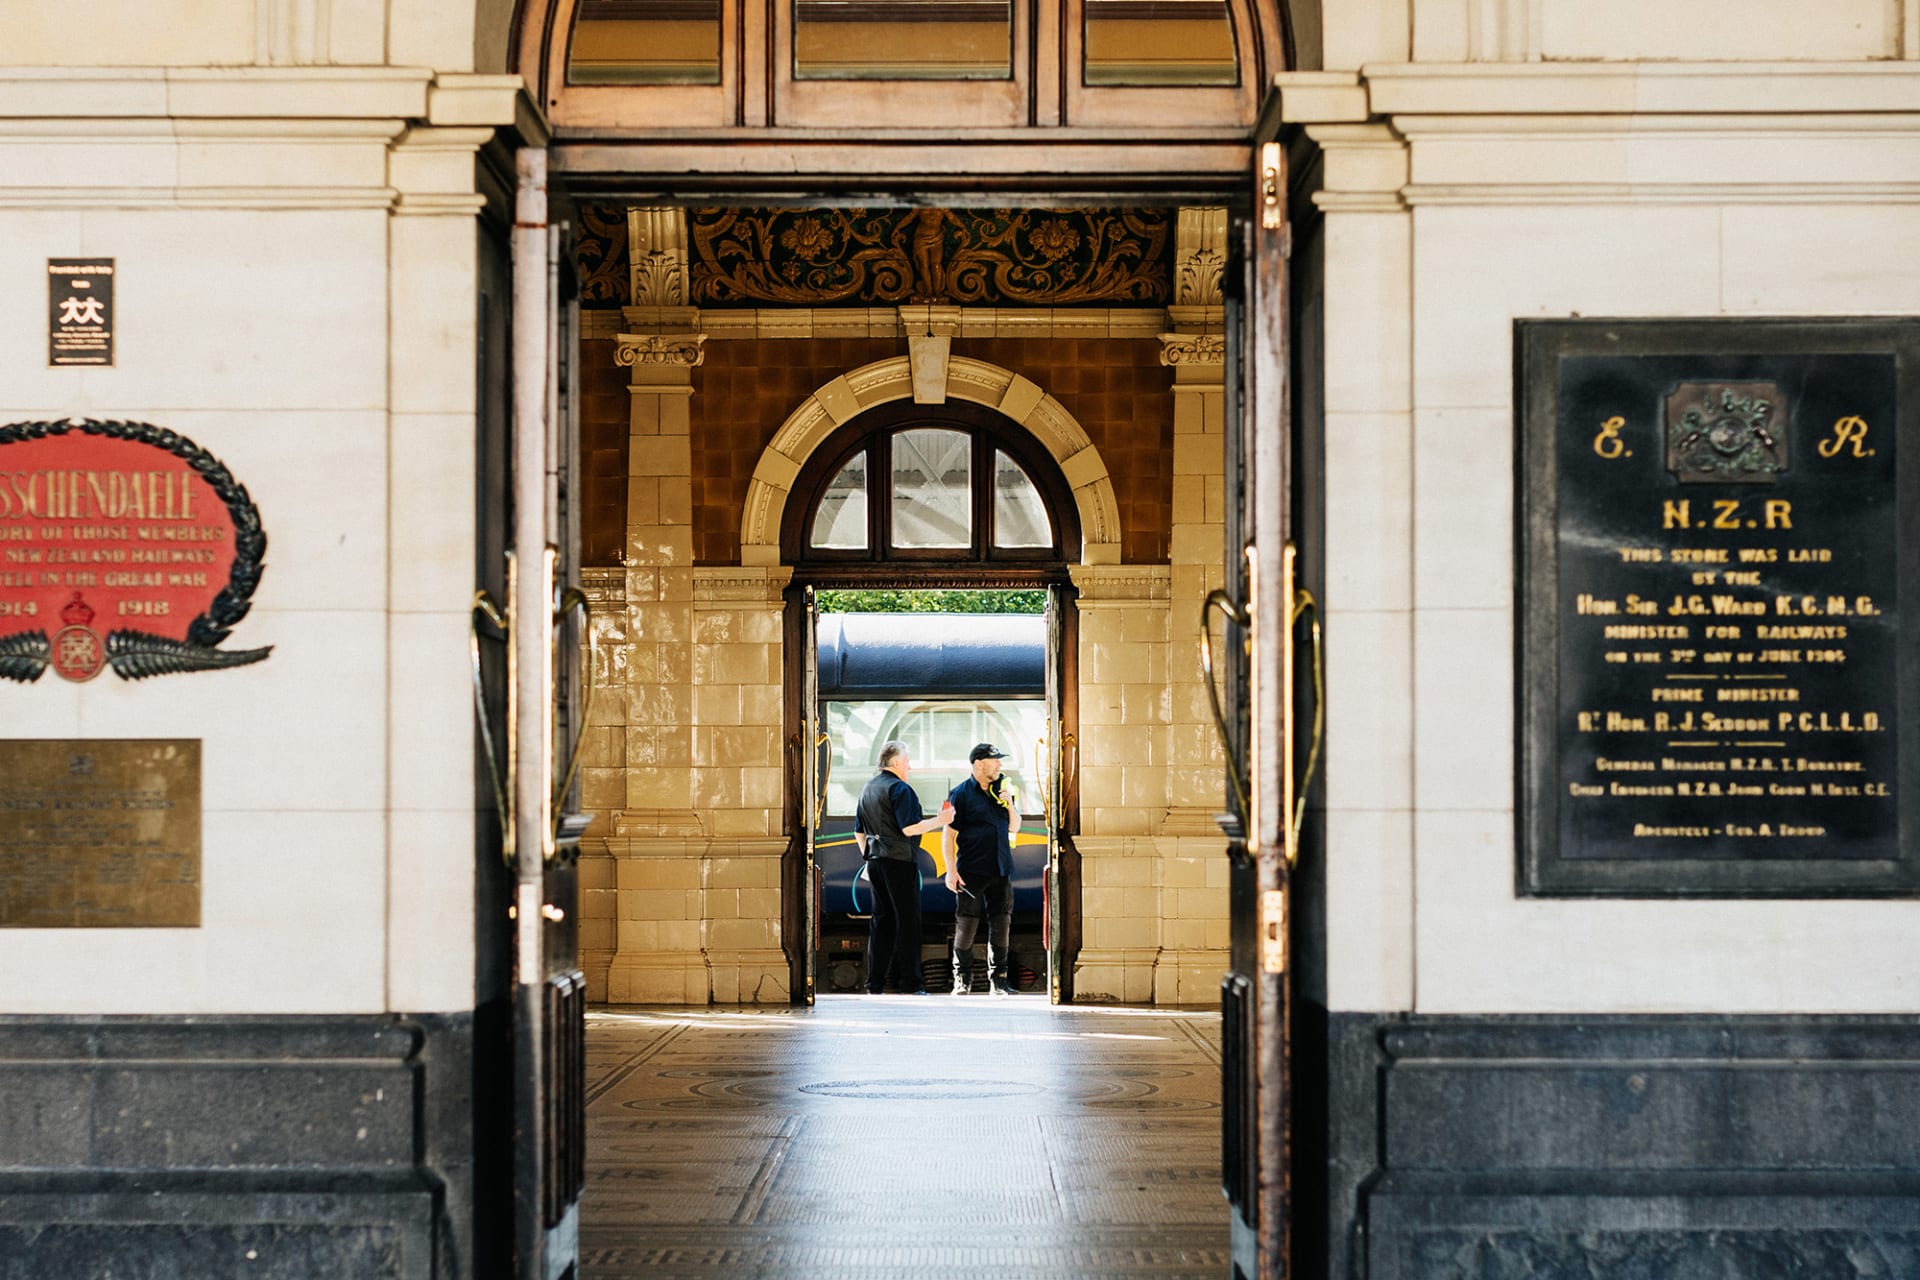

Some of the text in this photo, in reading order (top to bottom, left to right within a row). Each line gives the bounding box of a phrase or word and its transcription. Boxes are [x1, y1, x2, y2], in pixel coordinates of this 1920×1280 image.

[41, 526, 63, 541] OF
[72, 526, 129, 541] THOSE
[137, 525, 226, 541] MEMBERS
[6, 548, 216, 564] NEW ZEALAND RAILWAYS
[1619, 548, 1833, 564] THIS STONE WAS LAID
[65, 571, 97, 587] THE
[104, 571, 163, 587] GREAT
[168, 571, 208, 587] WAR
[1691, 570, 1762, 586] BY THE
[118, 600, 170, 617] 1918
[1625, 593, 1659, 616] SIR
[1604, 625, 1848, 640] MINISTER FOR RAILWAYS
[1604, 651, 1628, 663] ON
[1632, 651, 1663, 663] THE
[1703, 651, 1733, 664] DAY
[1758, 649, 1803, 663] JUNE
[1651, 688, 1800, 702] PRIME MINISTER
